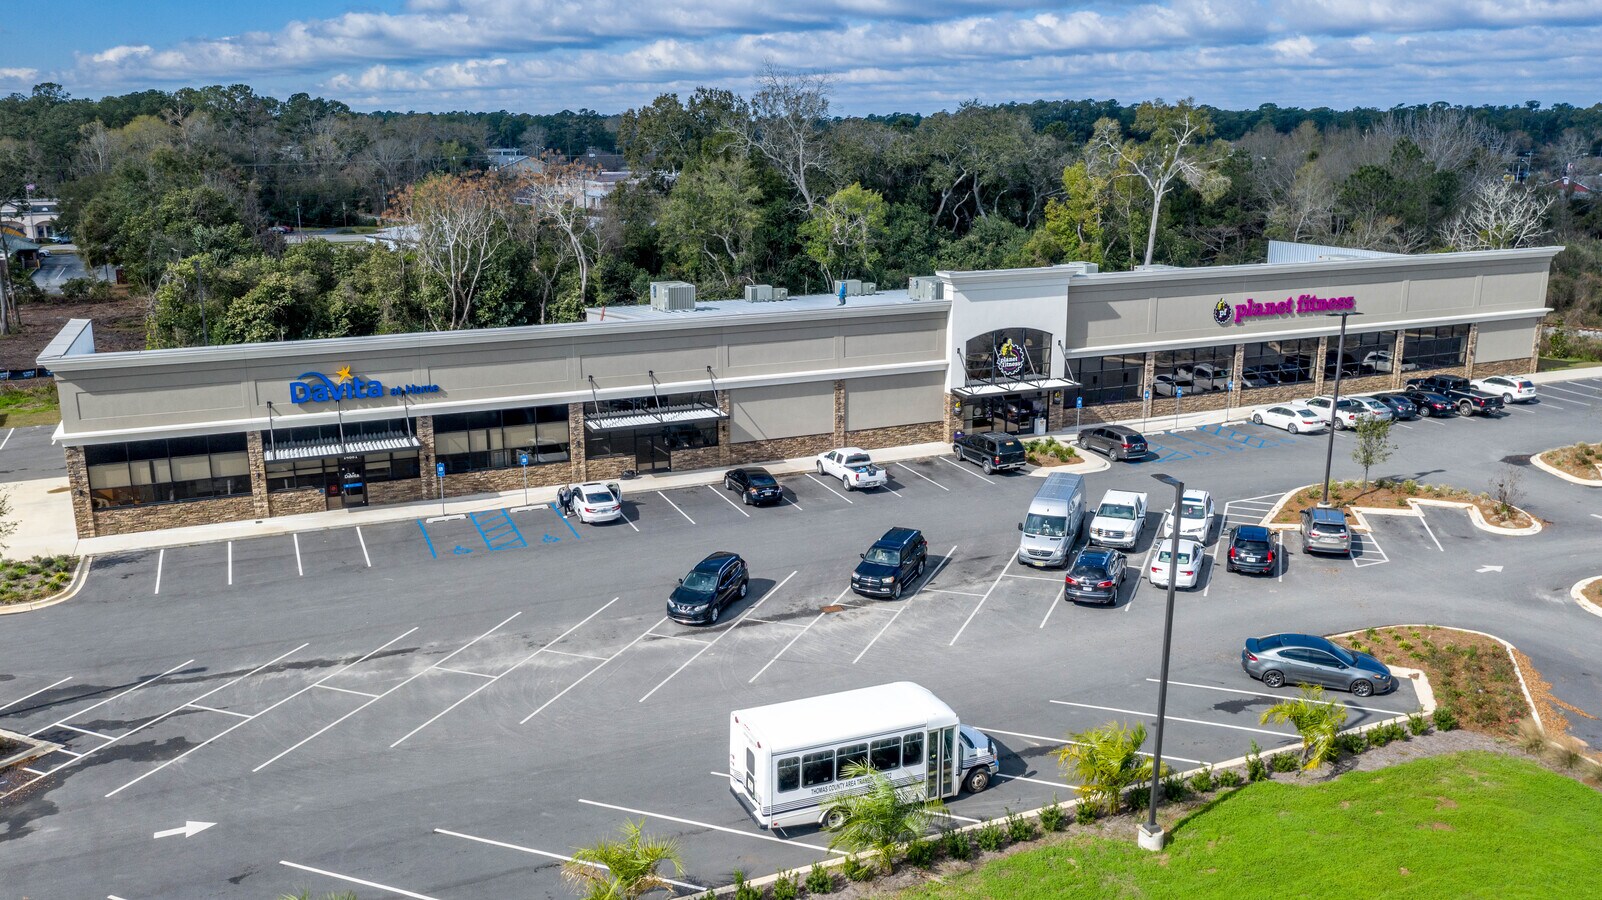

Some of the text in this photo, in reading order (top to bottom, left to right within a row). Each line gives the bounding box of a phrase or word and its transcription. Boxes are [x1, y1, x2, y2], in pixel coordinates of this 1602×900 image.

[1235, 294, 1354, 322] planet fitness
[290, 371, 440, 404] DaVita at Home
[811, 786, 828, 795] THOMAS
[828, 782, 845, 792] COUNTY
[845, 780, 857, 789] AREA
